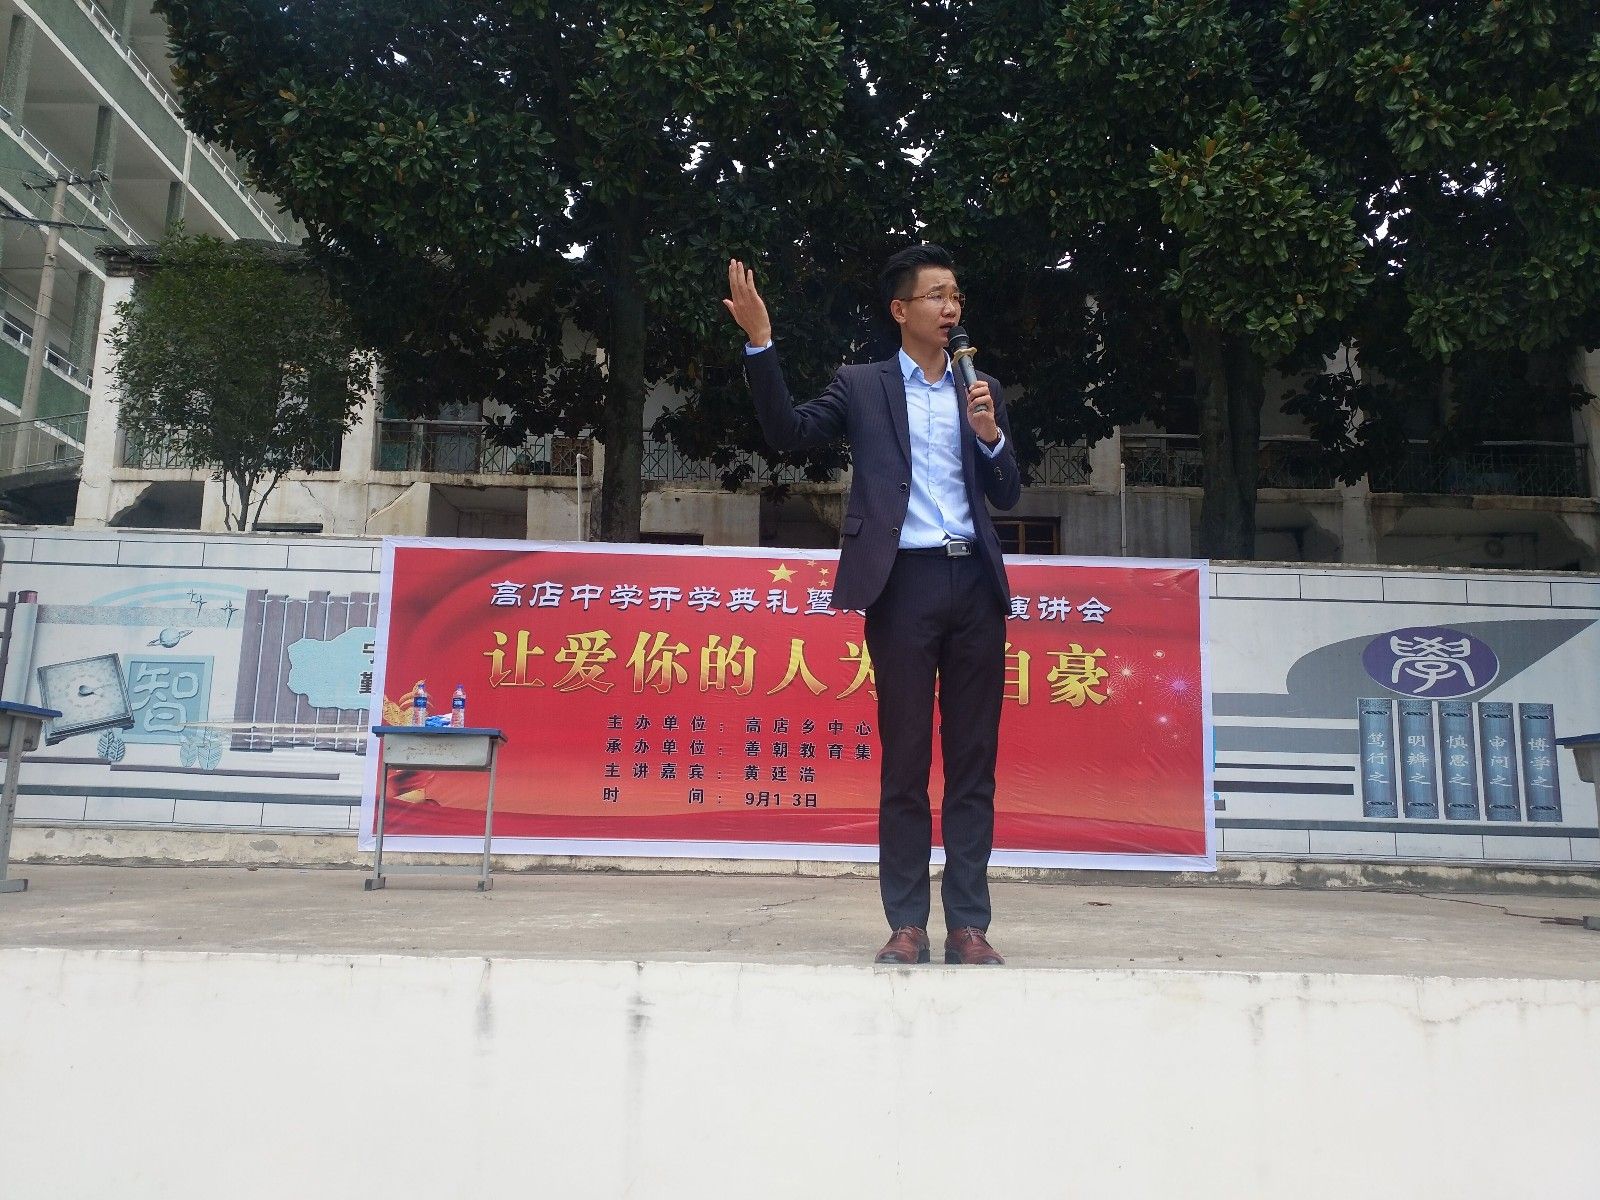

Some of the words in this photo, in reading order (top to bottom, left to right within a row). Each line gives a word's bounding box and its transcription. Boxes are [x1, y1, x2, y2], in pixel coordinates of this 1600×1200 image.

[490, 580, 1112, 623] 高店中学开学典礼暨演讲会
[483, 629, 1109, 708] 让爱你的人为自豪
[131, 663, 200, 733] 智
[1366, 732, 1390, 784] 笃行之
[1446, 735, 1471, 786] 慎思之
